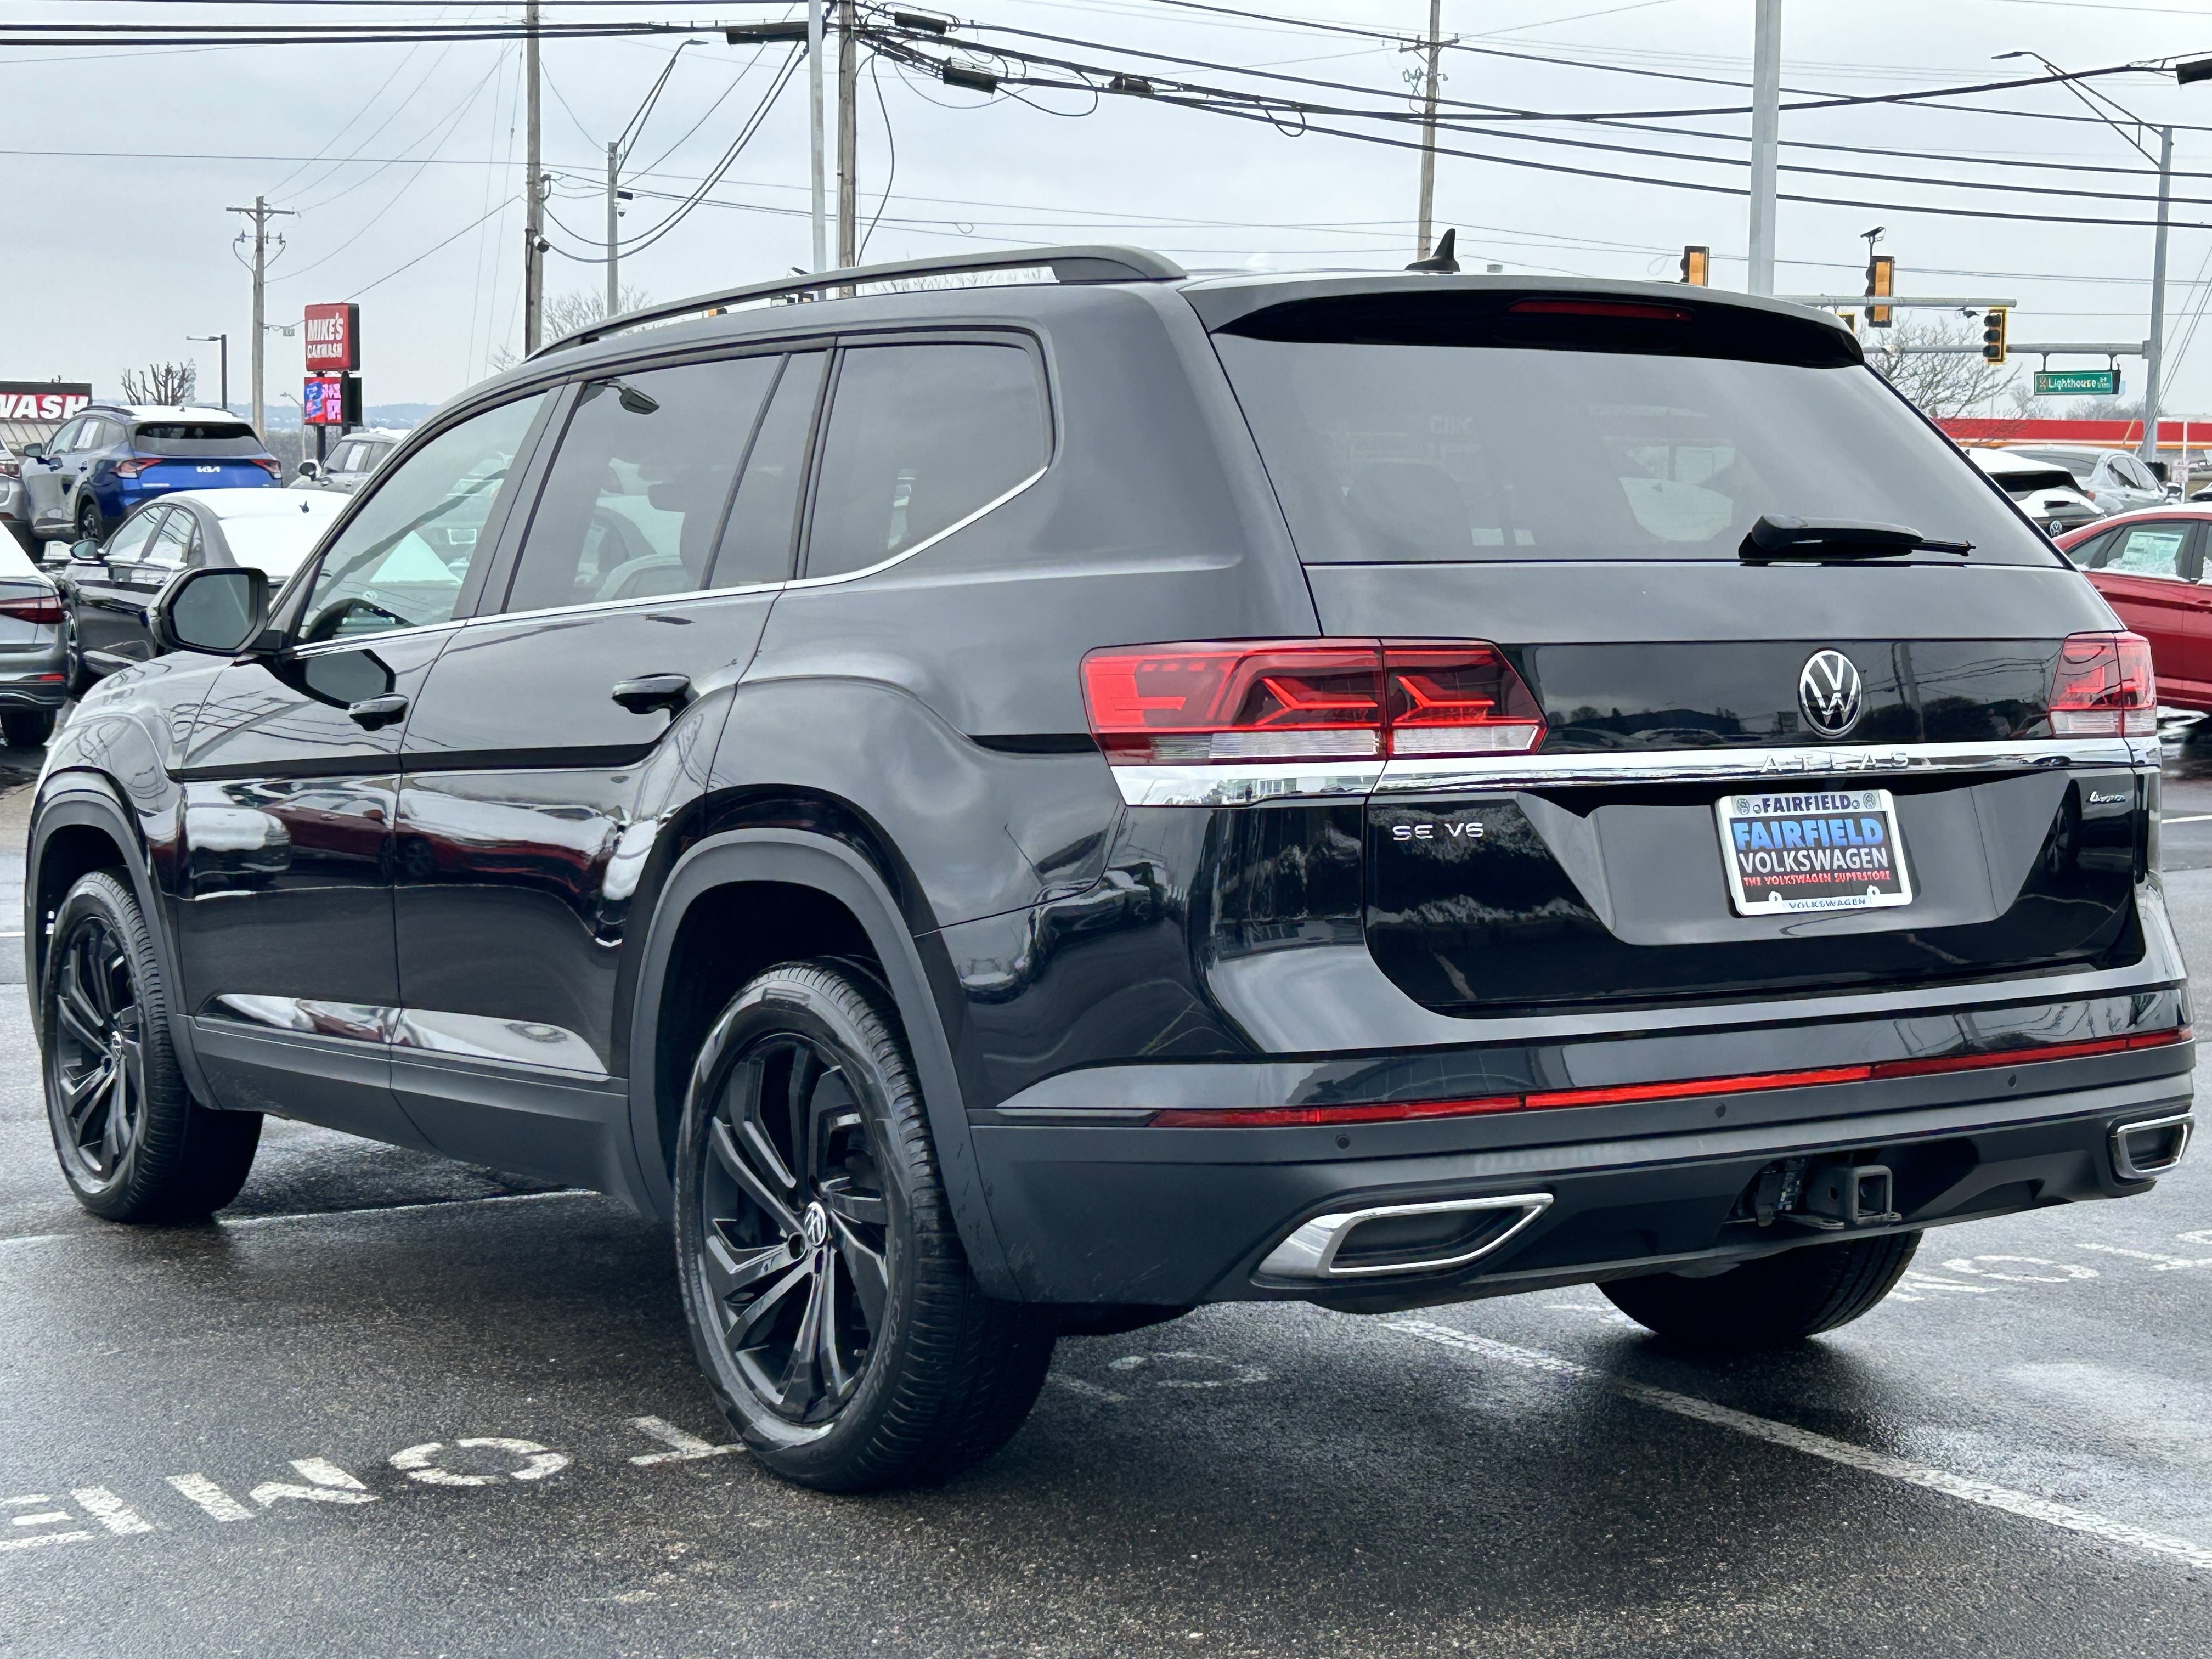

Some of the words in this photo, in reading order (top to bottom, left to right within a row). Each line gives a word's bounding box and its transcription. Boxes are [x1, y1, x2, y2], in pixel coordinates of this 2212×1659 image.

[307, 312, 343, 341] MIKE'S
[2049, 377, 2096, 390] Lighthouse
[1760, 752, 1908, 774] ATLAS
[1762, 795, 1851, 813] FAIRFIELD
[1393, 825, 1434, 840] SE
[1444, 822, 1483, 837] V6
[1733, 818, 1884, 850] FAIRFIELD
[1739, 847, 1888, 873] VOLKSWAGEN
[1764, 872, 1831, 885] VOLKSWAGEN
[1788, 898, 1865, 909] VOLKSWAGEN
